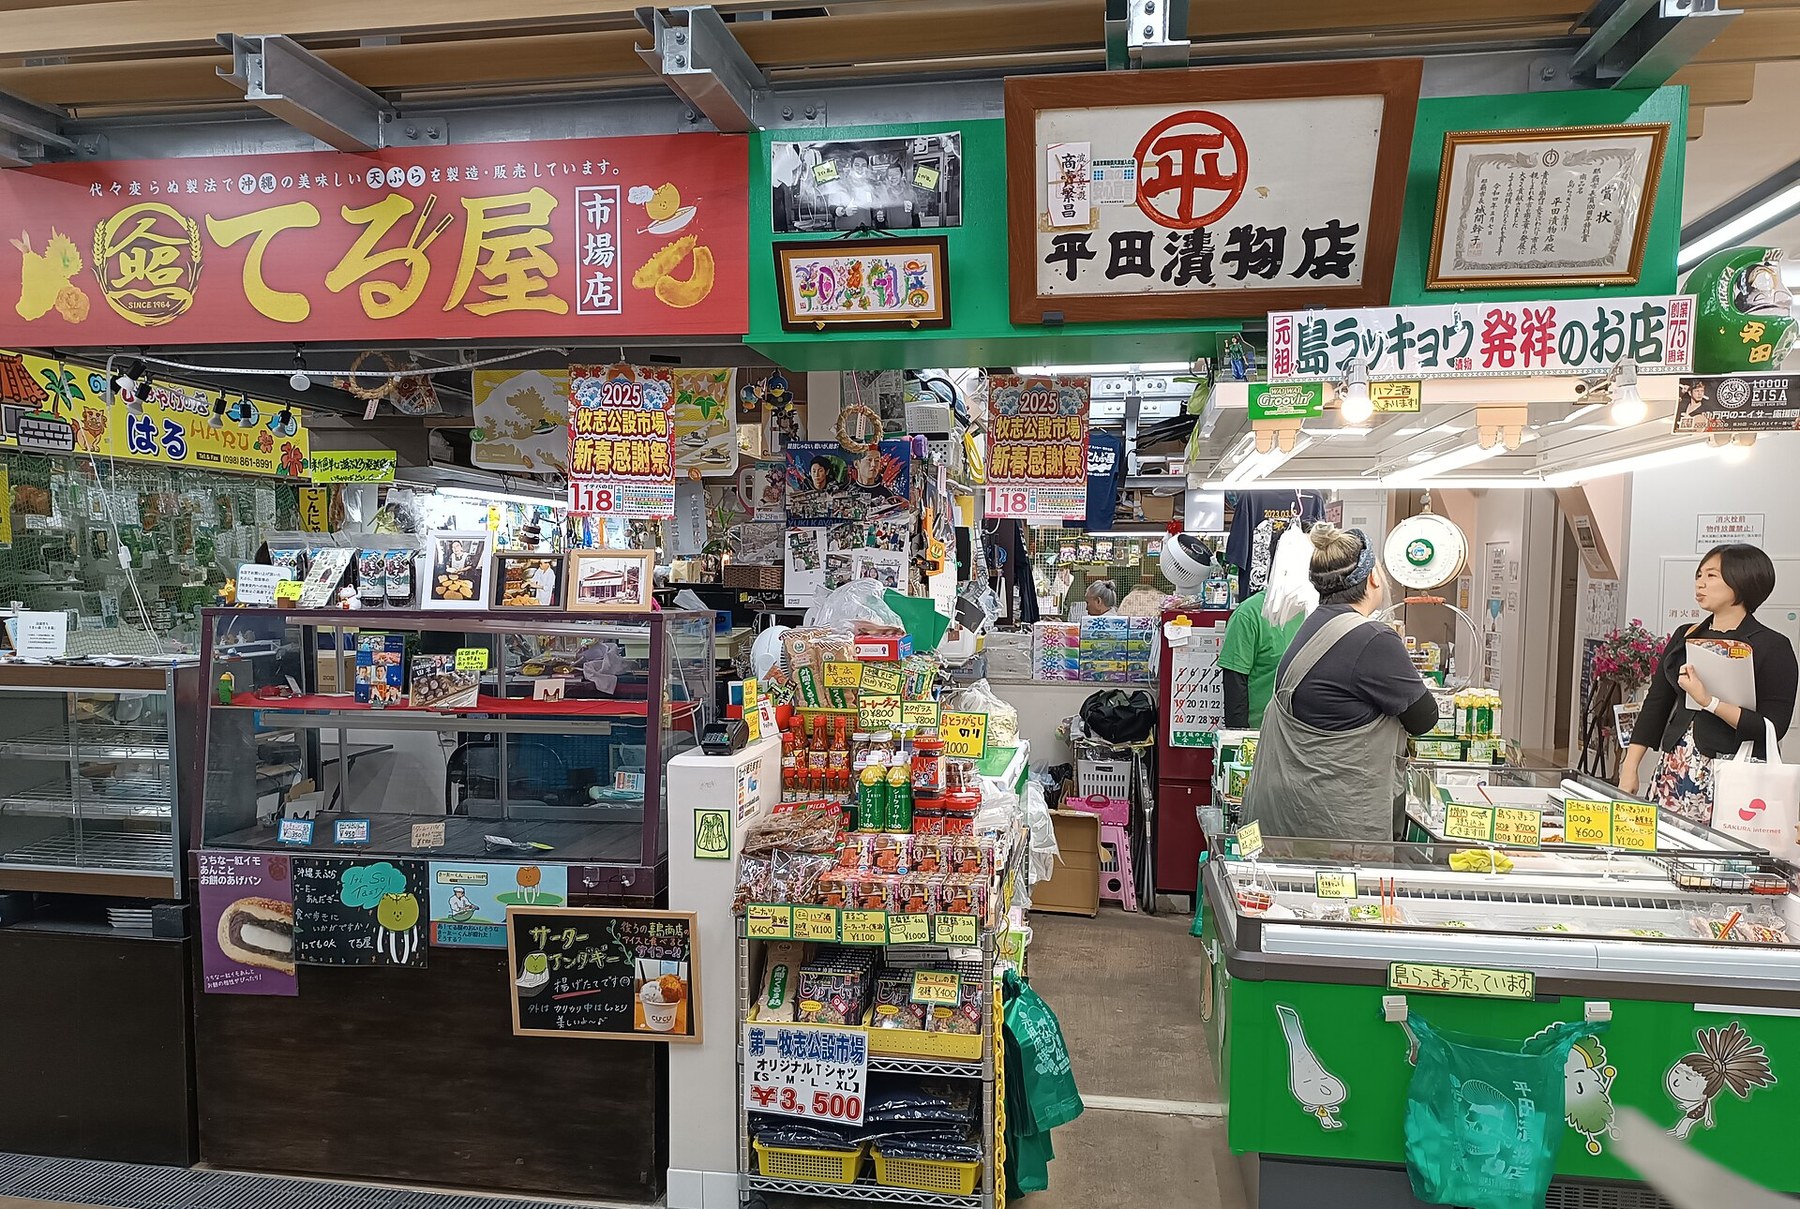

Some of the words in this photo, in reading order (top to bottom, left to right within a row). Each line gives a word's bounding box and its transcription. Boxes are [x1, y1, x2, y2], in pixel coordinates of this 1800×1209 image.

[1596, 184, 1617, 224] 賞状
[205, 186, 569, 323] てる屋
[582, 192, 616, 309] 市場店
[1045, 218, 1360, 286] 平田漬物店
[128, 301, 152, 310] SINCE
[153, 301, 171, 309] 1964
[1671, 301, 1688, 318] 創業
[1669, 319, 1688, 348] 75
[1668, 349, 1686, 364] 周年
[1752, 379, 1789, 389] 10000
[602, 383, 642, 406] 2025
[1751, 389, 1788, 401] EISA
[1020, 392, 1058, 414] 2025
[577, 407, 667, 437] 牧志公設市場
[995, 415, 1081, 442] 牧志公設市場
[127, 413, 187, 460] はる
[240, 456, 273, 469] 861-8991
[573, 438, 670, 474] 新春感謝祭
[991, 445, 1083, 480] 新春感謝祭
[570, 482, 613, 512] 1.18
[986, 487, 1028, 513] 1.18
[1668, 609, 1700, 618] 消火器
[1200, 684, 1209, 693] 14
[1211, 685, 1221, 694] 15
[1186, 699, 1197, 708] 20
[1199, 700, 1209, 709] 21
[1210, 700, 1221, 709] 22
[869, 709, 894, 718] ¥800
[1174, 714, 1184, 723] 26
[1186, 715, 1196, 724] 27
[1198, 715, 1208, 724] 28
[913, 716, 936, 725] ¥800
[940, 714, 984, 728] 島とうがらし
[1497, 808, 1536, 821] 島らっきょう
[1568, 814, 1592, 825] 100g
[1514, 822, 1537, 833] ¥700
[1574, 826, 1604, 839] ¥600
[1722, 822, 1752, 832] SAKURA
[1752, 826, 1782, 834] internet
[200, 855, 261, 866] うちなー紅イモ
[200, 866, 235, 876] あんこと
[200, 876, 262, 886] お餅のあげパン
[845, 912, 869, 920] まるごと
[750, 924, 776, 935] ¥400
[529, 925, 590, 950] サーター
[903, 932, 927, 941] ¥1000
[949, 934, 974, 942] ¥1000
[549, 944, 621, 972] アンダギー
[1392, 965, 1533, 998] 島らっきょう売っています。
[933, 986, 957, 998] ¥400
[748, 1028, 866, 1066] 第一牧志公設市場
[756, 1058, 859, 1080] オリジナルTシャツ
